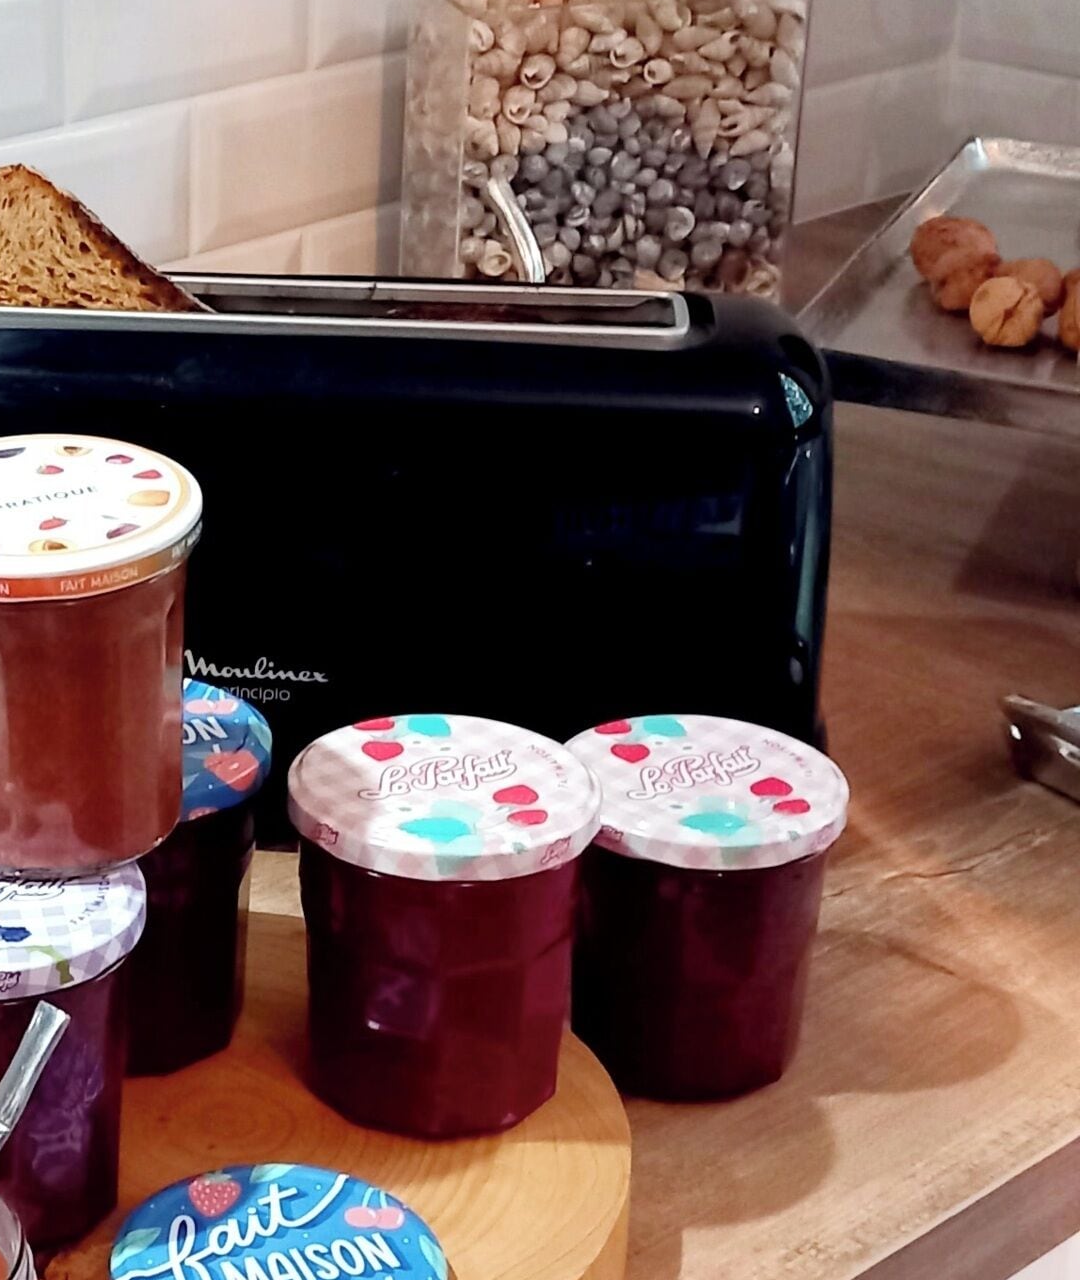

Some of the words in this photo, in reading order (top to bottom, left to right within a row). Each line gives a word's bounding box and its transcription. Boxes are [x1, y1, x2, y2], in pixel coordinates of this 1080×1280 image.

[60, 578, 86, 593] FAIT
[90, 567, 139, 588] MAISON
[184, 649, 329, 683] Moulinex
[358, 764, 412, 800] Le
[408, 749, 517, 791] Parfait
[627, 766, 674, 800] Le
[663, 747, 762, 788] Parfait
